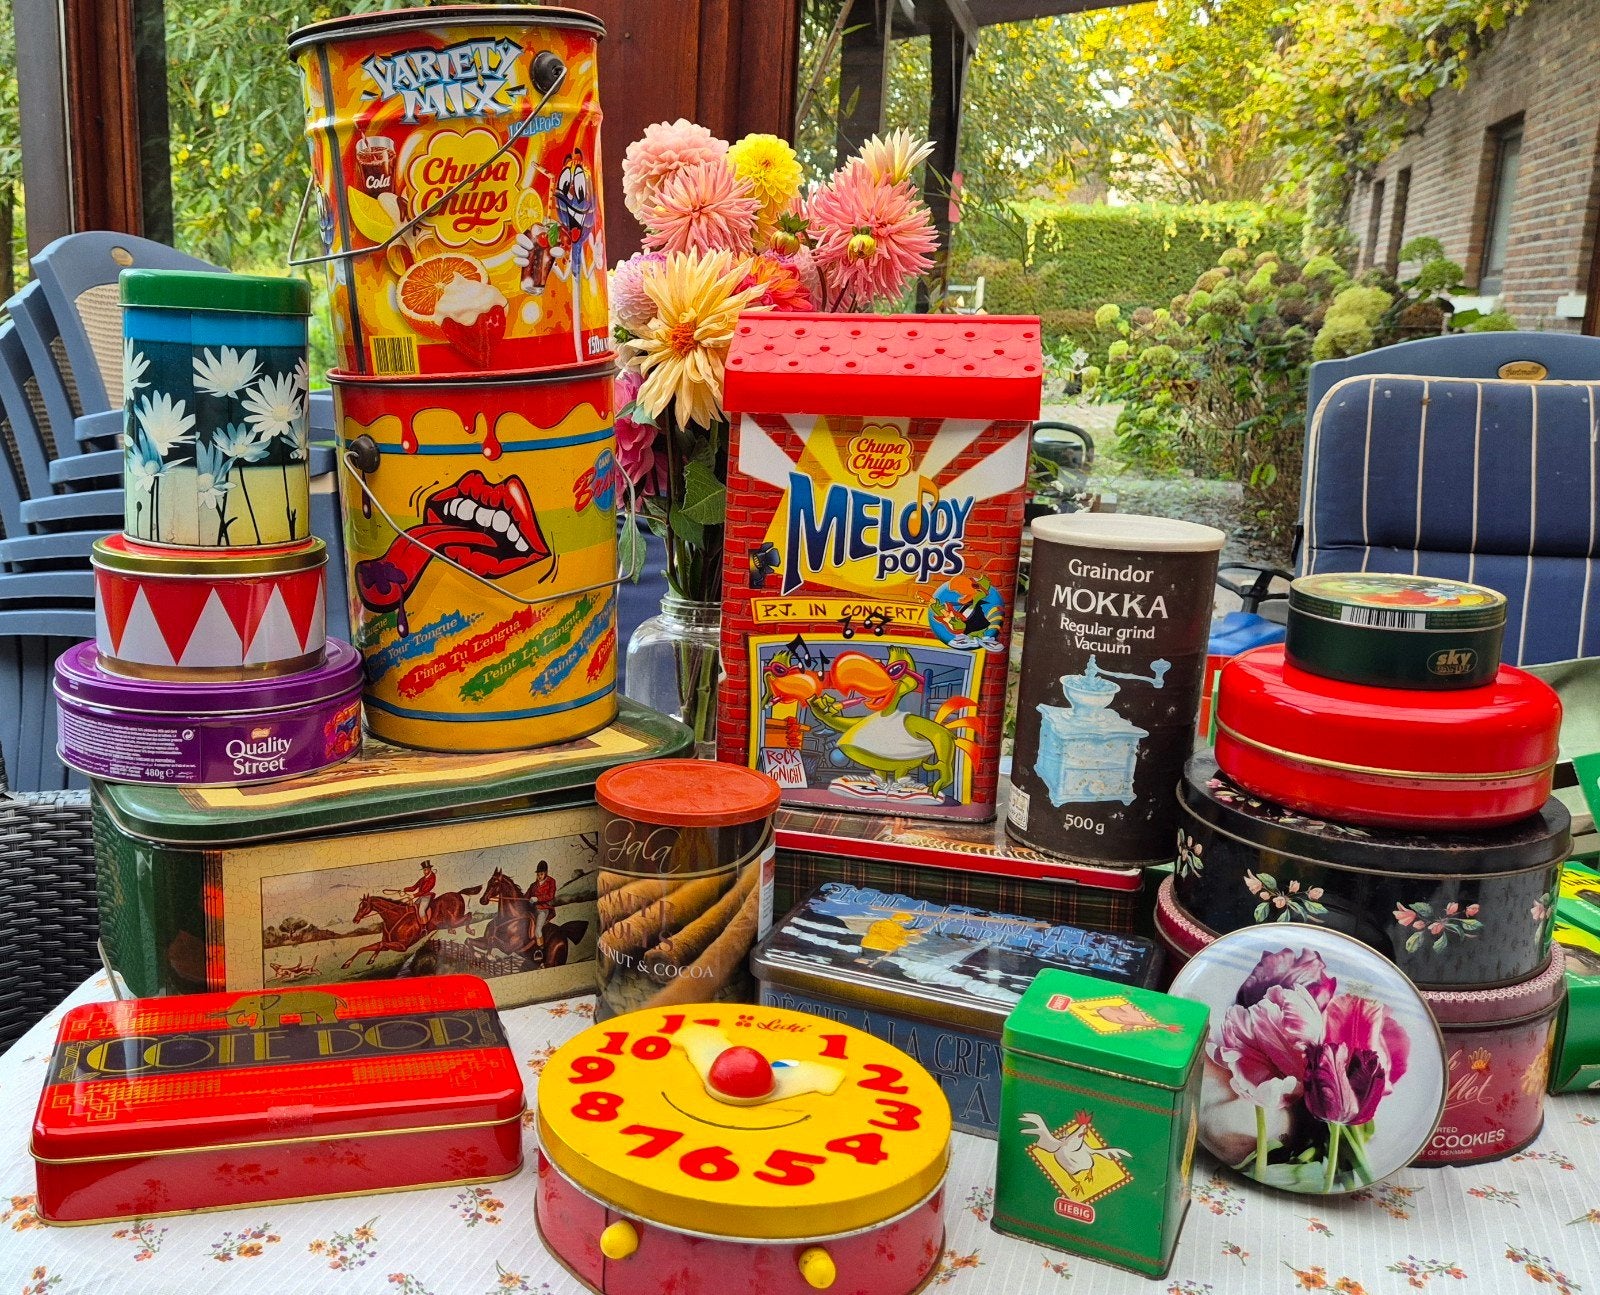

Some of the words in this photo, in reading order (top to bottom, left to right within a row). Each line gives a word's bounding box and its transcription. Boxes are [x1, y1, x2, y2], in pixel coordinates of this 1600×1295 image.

[362, 37, 523, 100] VARIETY
[402, 78, 512, 124] MIX
[366, 175, 391, 189] Cola
[423, 157, 511, 191] Chupa
[421, 186, 508, 233] Chups
[857, 438, 906, 458] Chupa
[853, 454, 901, 479] Chups
[782, 471, 975, 597] MELODY
[875, 542, 965, 584] pops
[1068, 558, 1154, 583] Graindor
[762, 603, 797, 618] P.J.
[809, 603, 826, 616] IN
[841, 604, 926, 624] CONCERT!
[1051, 584, 1169, 619] MOKKA
[388, 643, 410, 660] Your
[412, 618, 458, 646] Tongue
[1060, 616, 1114, 637] Regular
[1116, 625, 1156, 641] grind
[414, 662, 447, 683] Pinta
[450, 650, 468, 665] Tu
[472, 621, 521, 654] Lengua
[482, 657, 517, 685] Peint
[521, 646, 539, 662] La
[542, 610, 580, 648] Langue
[1074, 636, 1131, 655] Vacuum
[1436, 649, 1473, 667] sky
[226, 736, 293, 761] Quality
[144, 767, 165, 779] 480g
[233, 757, 286, 776] Street
[605, 819, 682, 875] Gala
[637, 960, 651, 974] &
[653, 962, 714, 979] COCOA
[87, 1029, 291, 1073] CÔTE
[314, 1017, 473, 1056] D'OR
[596, 1032, 672, 1060] 10
[817, 1034, 848, 1059] 1
[568, 1056, 615, 1084] 9
[857, 1064, 909, 1094] 2
[571, 1091, 624, 1122] 8
[868, 1099, 922, 1131] 3
[620, 1124, 684, 1158] 7
[826, 1133, 888, 1165] 4
[1431, 1128, 1506, 1148] COOKIES
[1440, 1148, 1473, 1156] DENMARK
[679, 1146, 740, 1181] 6
[754, 1149, 827, 1186] 5
[1058, 1202, 1091, 1219] LIEBIG
